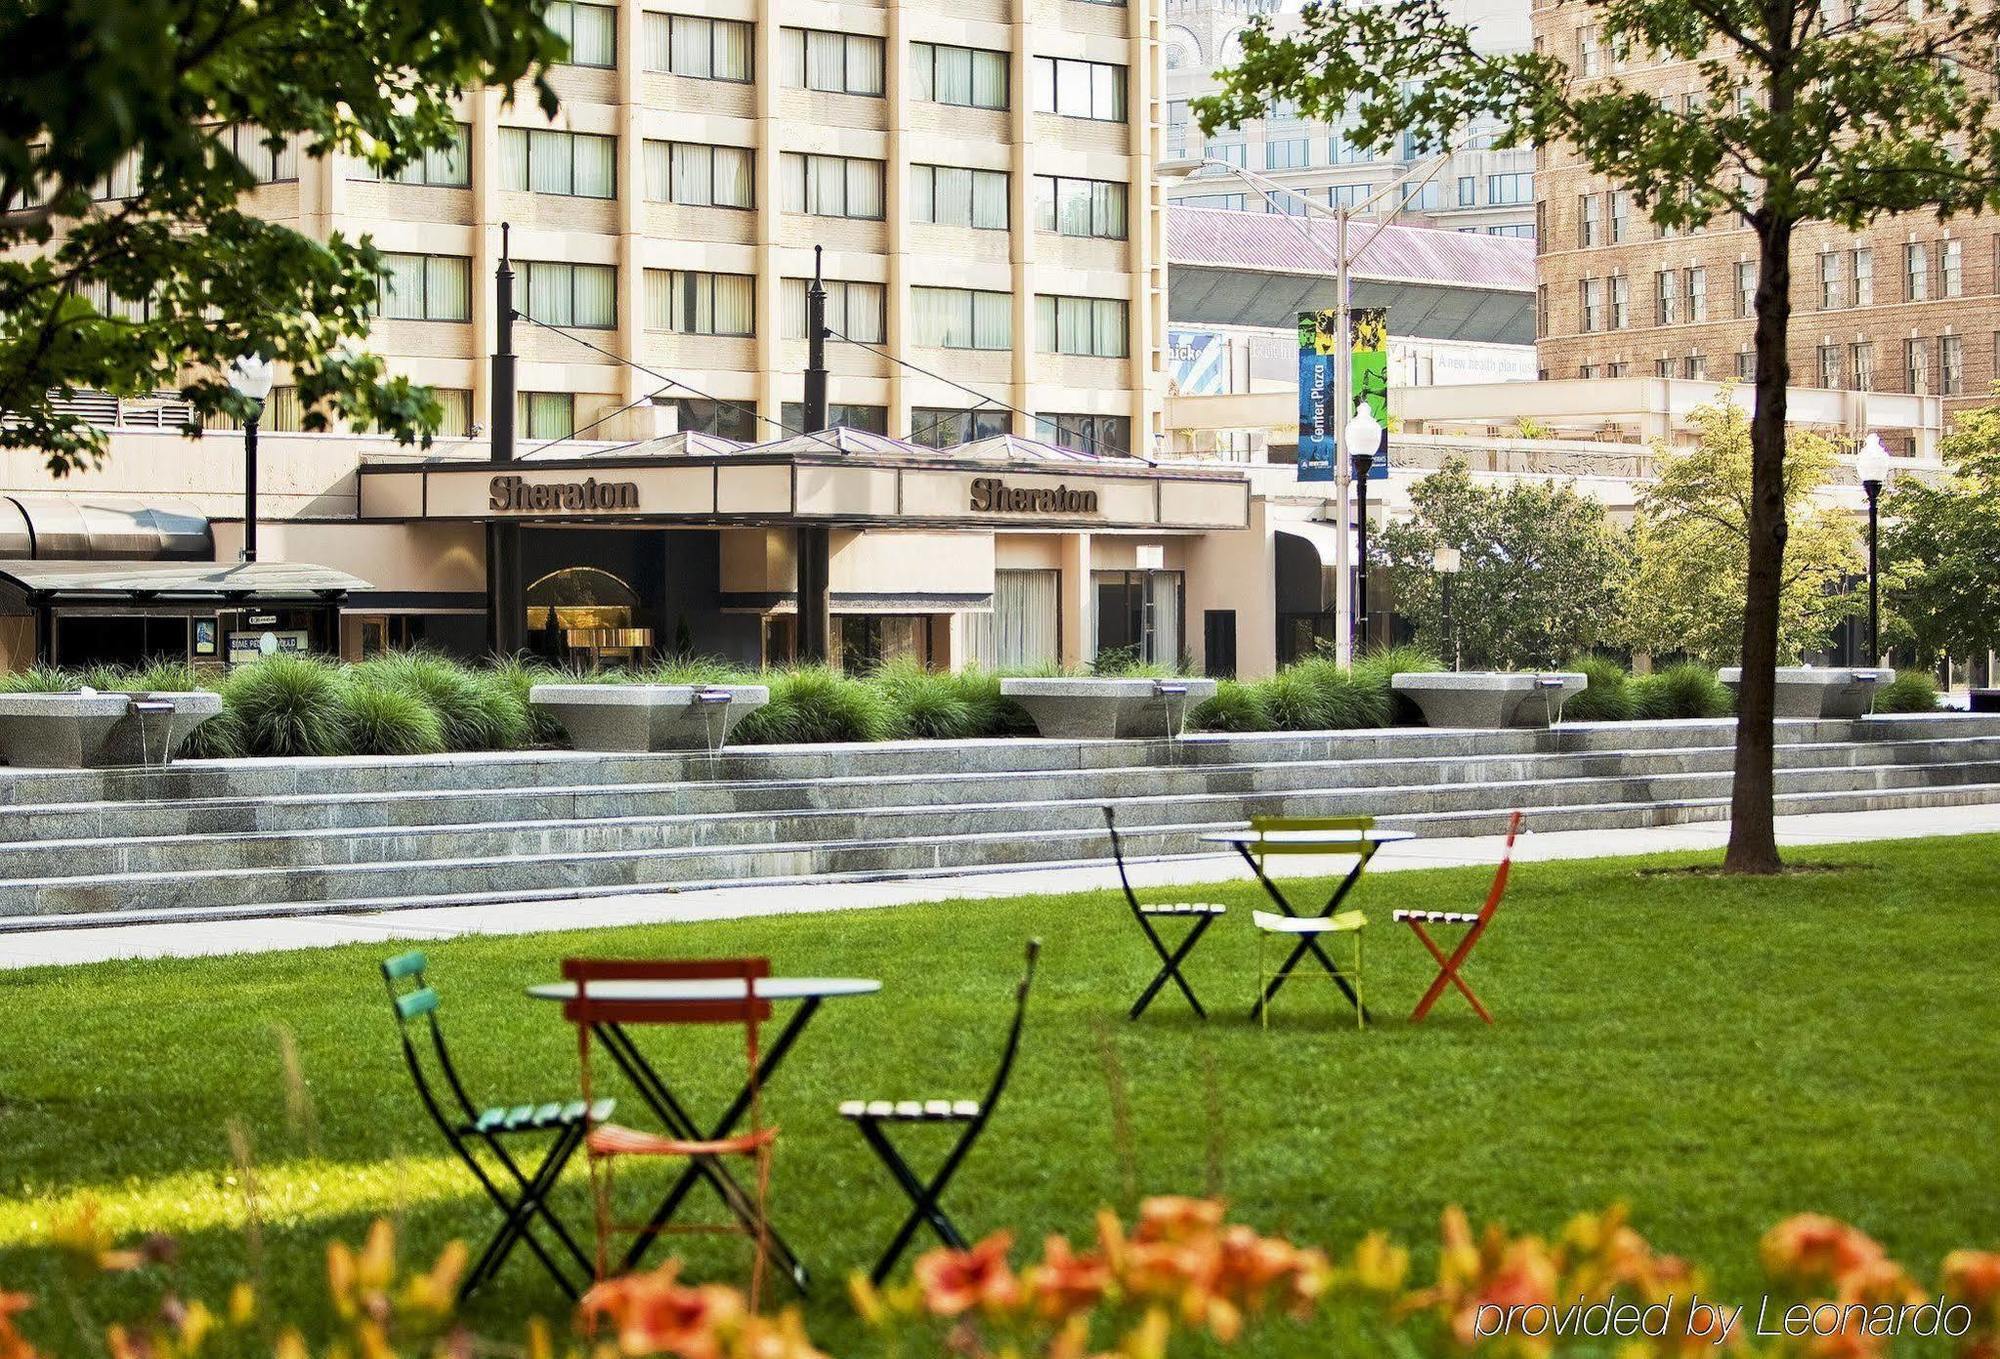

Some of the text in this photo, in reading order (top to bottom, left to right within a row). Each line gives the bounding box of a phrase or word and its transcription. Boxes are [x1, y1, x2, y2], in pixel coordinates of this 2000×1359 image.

[1310, 364, 1325, 400] Plaza
[1448, 357, 1467, 371] new
[1499, 359, 1520, 377] plan
[1310, 401, 1325, 443] Center
[489, 475, 640, 510] Sheraton
[970, 477, 1098, 512] Sheraton
